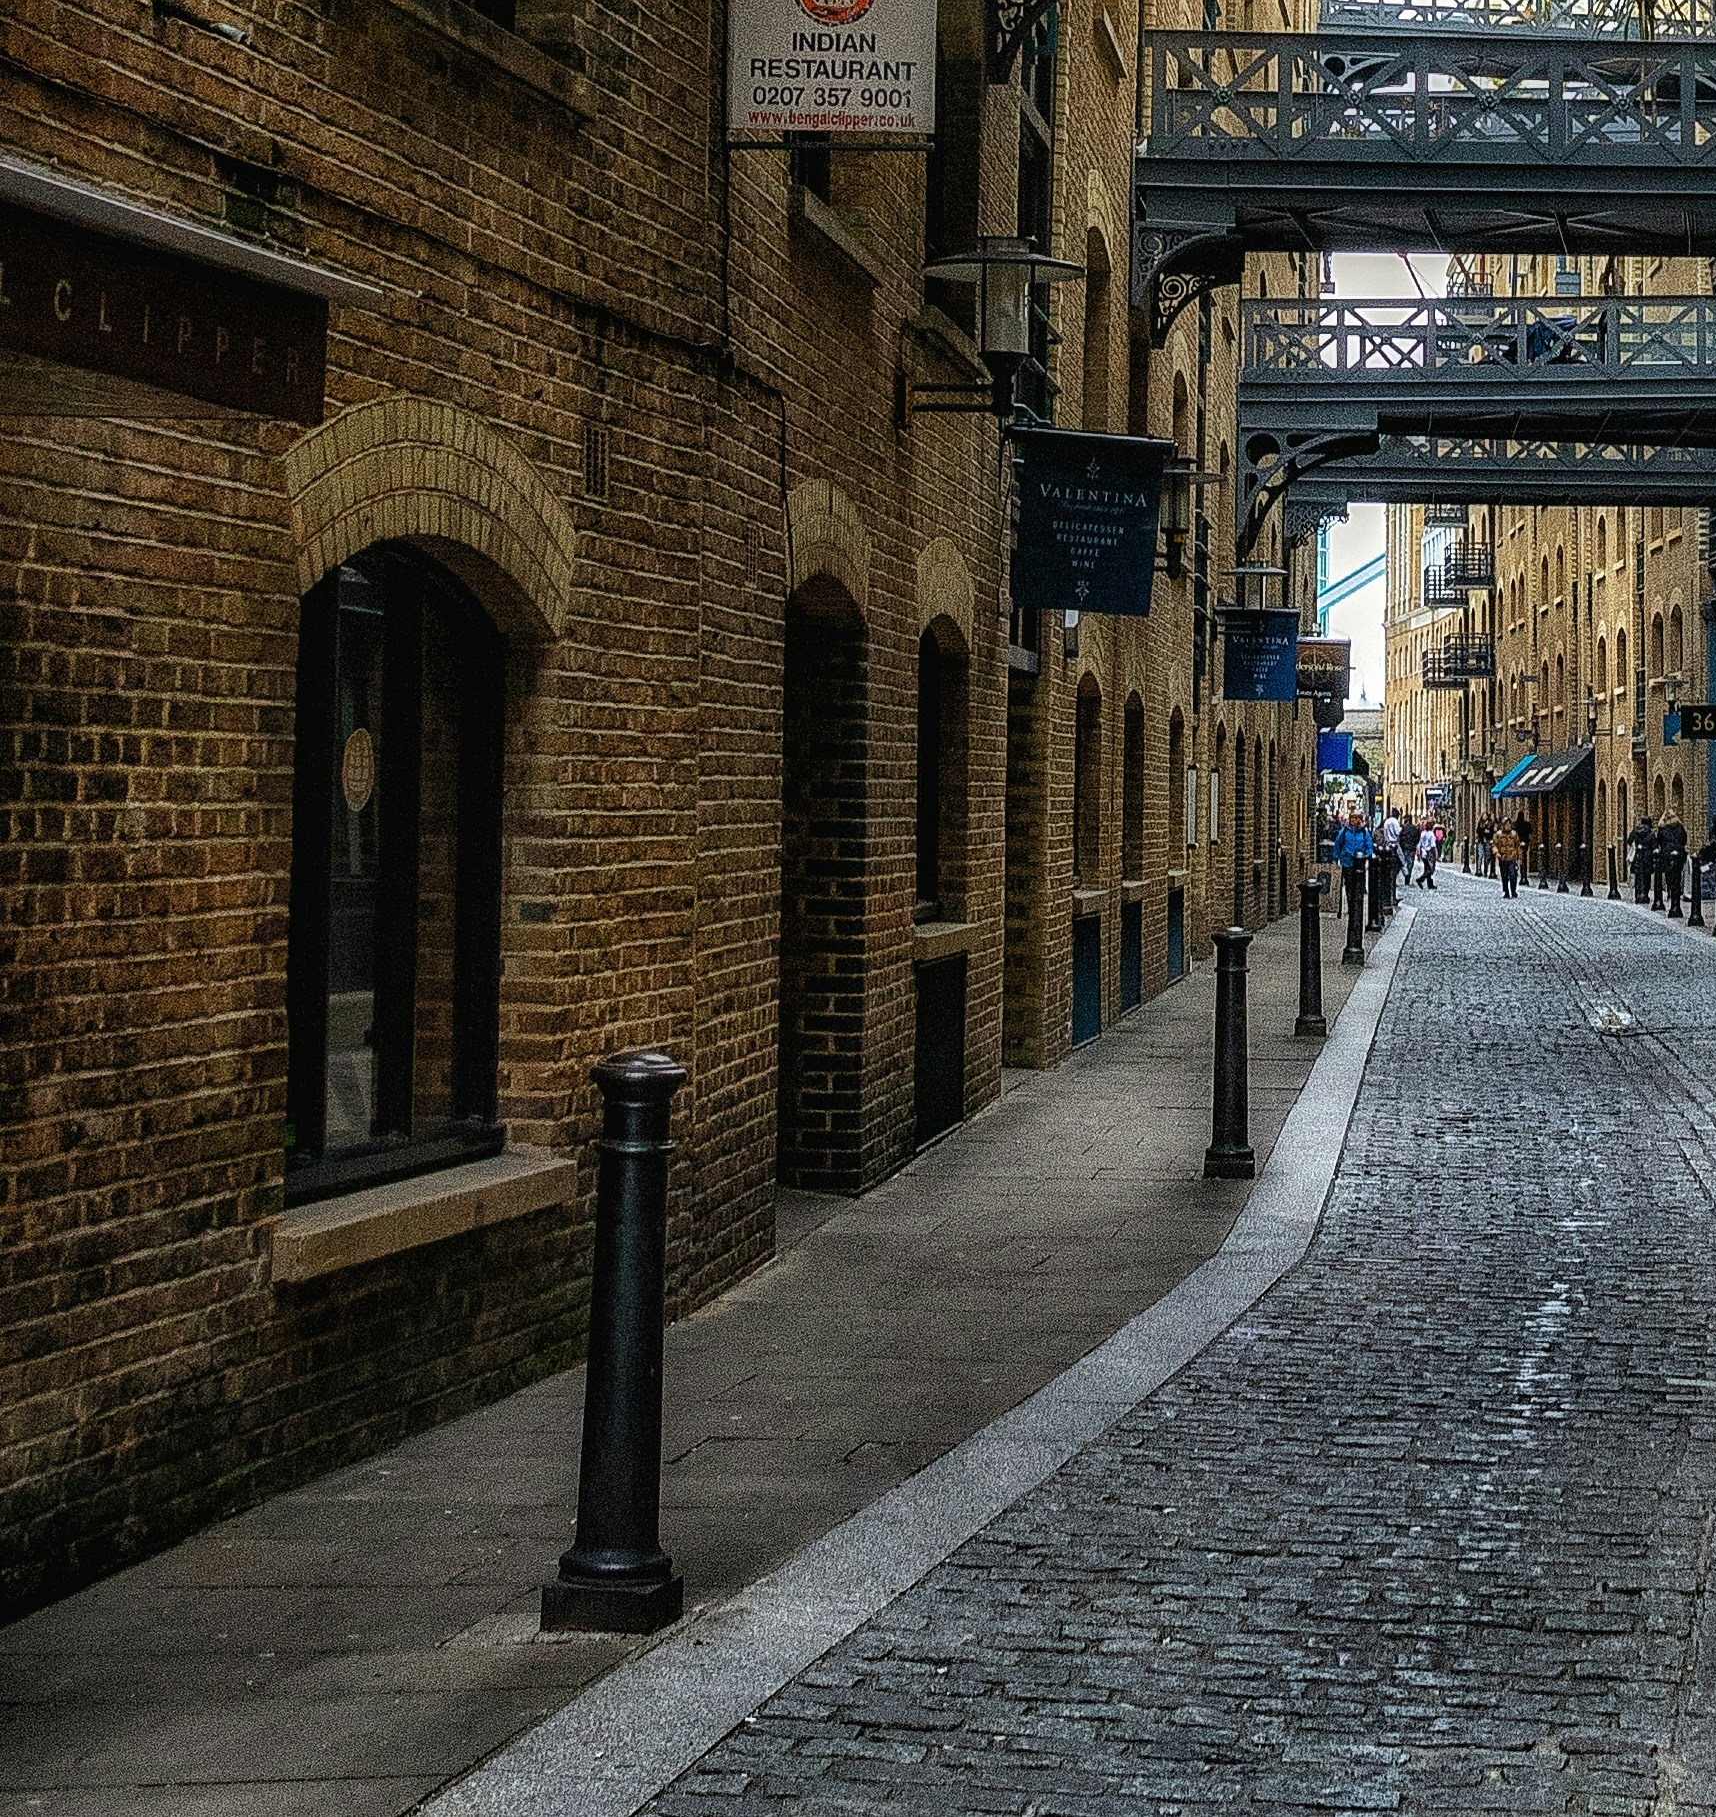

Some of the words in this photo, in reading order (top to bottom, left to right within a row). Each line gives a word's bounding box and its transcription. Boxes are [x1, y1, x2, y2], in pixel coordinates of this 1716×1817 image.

[791, 32, 877, 54] INDIAN
[749, 58, 918, 82] RESTAURANT
[752, 86, 804, 108] 0207
[812, 87, 852, 108] 357
[859, 87, 913, 109] 9001
[747, 109, 916, 131] www.bengalclipper.co.uk
[54, 278, 300, 384] CLIPPER
[1040, 483, 1148, 508] VALENTINA
[1056, 532, 1118, 546] RESTAURANT
[1691, 712, 1716, 733] 36
